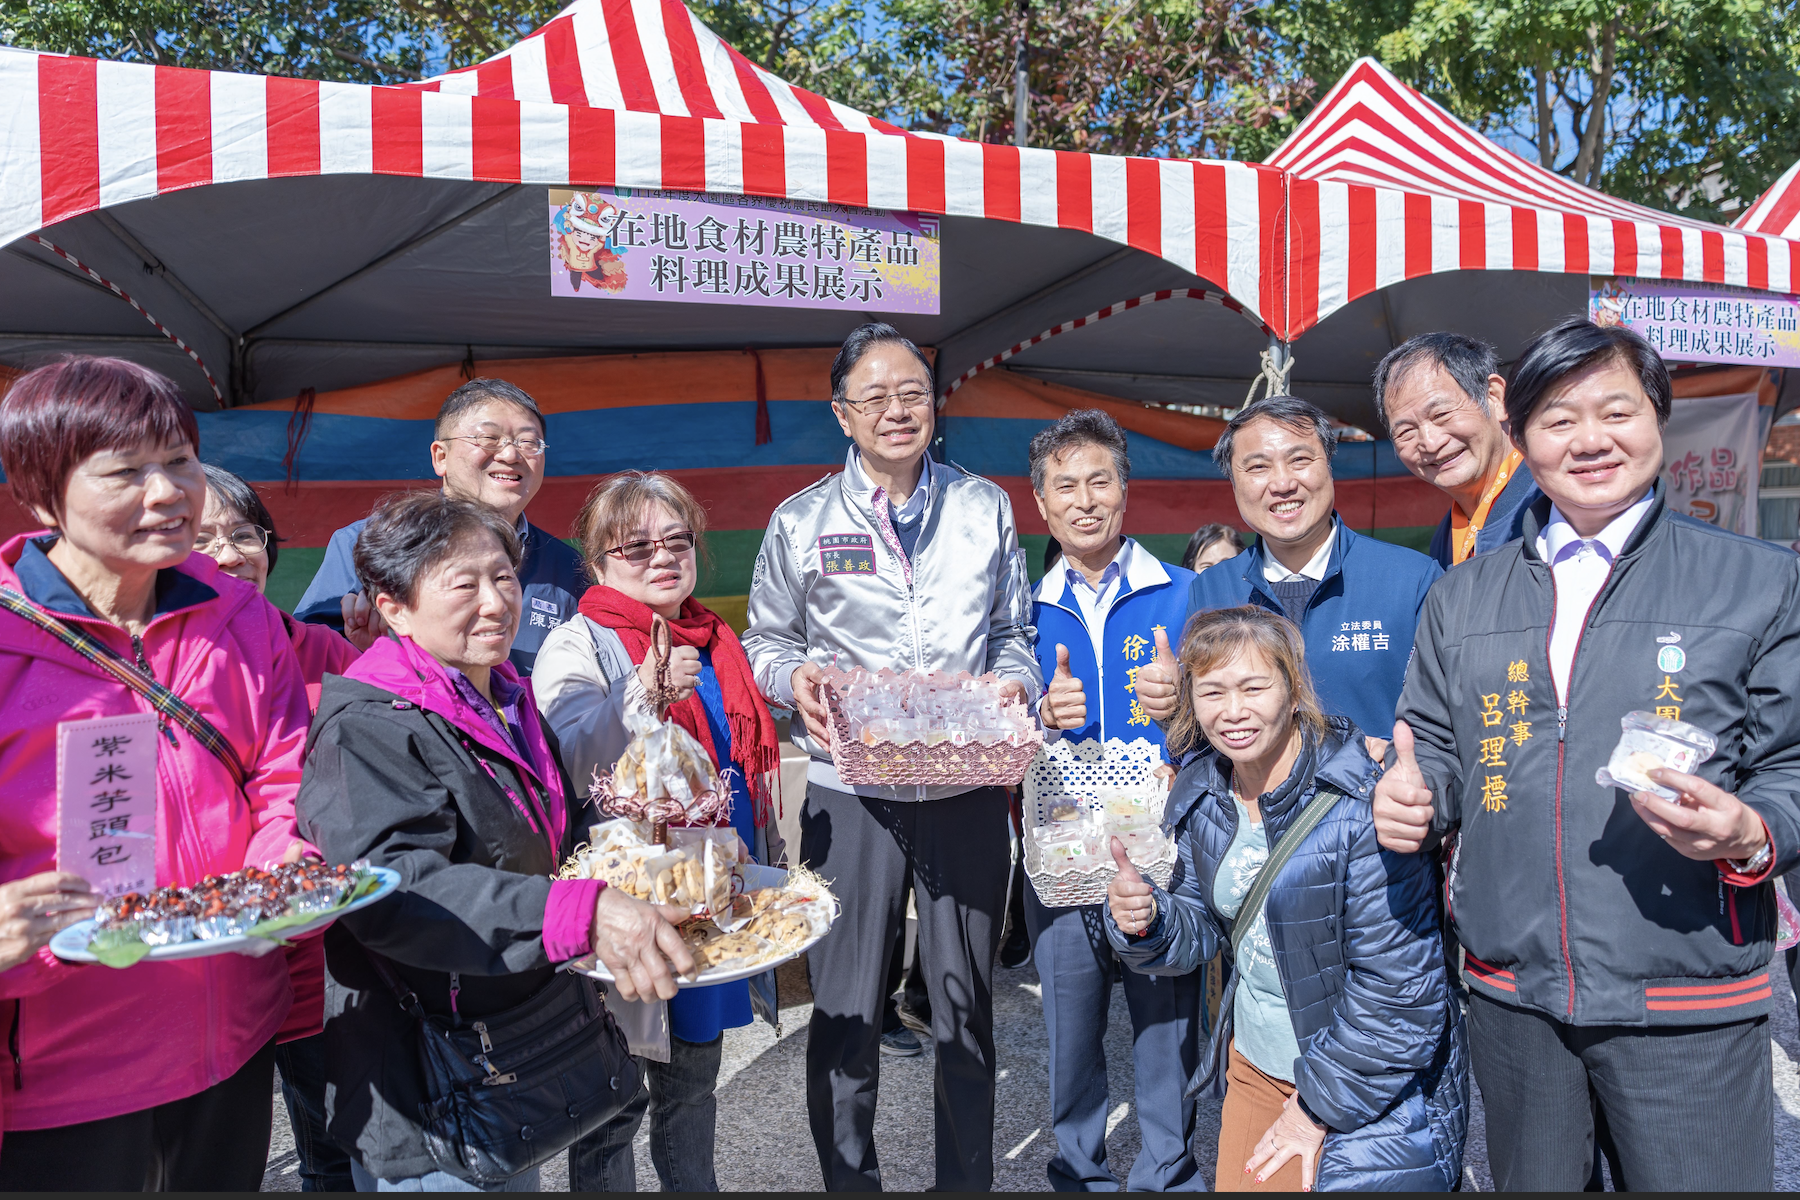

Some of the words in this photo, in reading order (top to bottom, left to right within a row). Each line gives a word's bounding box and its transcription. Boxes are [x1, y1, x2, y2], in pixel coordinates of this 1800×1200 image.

[607, 211, 919, 267] 在地食材農特產品
[649, 254, 884, 303] 料理成果展示
[1622, 294, 1797, 332] 在地食材農特產品
[1644, 325, 1776, 359] 料理成果展示
[822, 536, 868, 546] 桃園市政府
[823, 551, 841, 560] 市長
[825, 558, 873, 573] 張善政
[1331, 632, 1390, 652] 涂權吉
[1340, 620, 1383, 632] 立法委員
[1507, 659, 1534, 747] 總幹事
[1479, 692, 1509, 813] 呂理標
[89, 735, 134, 867] 紫米芋頭包
